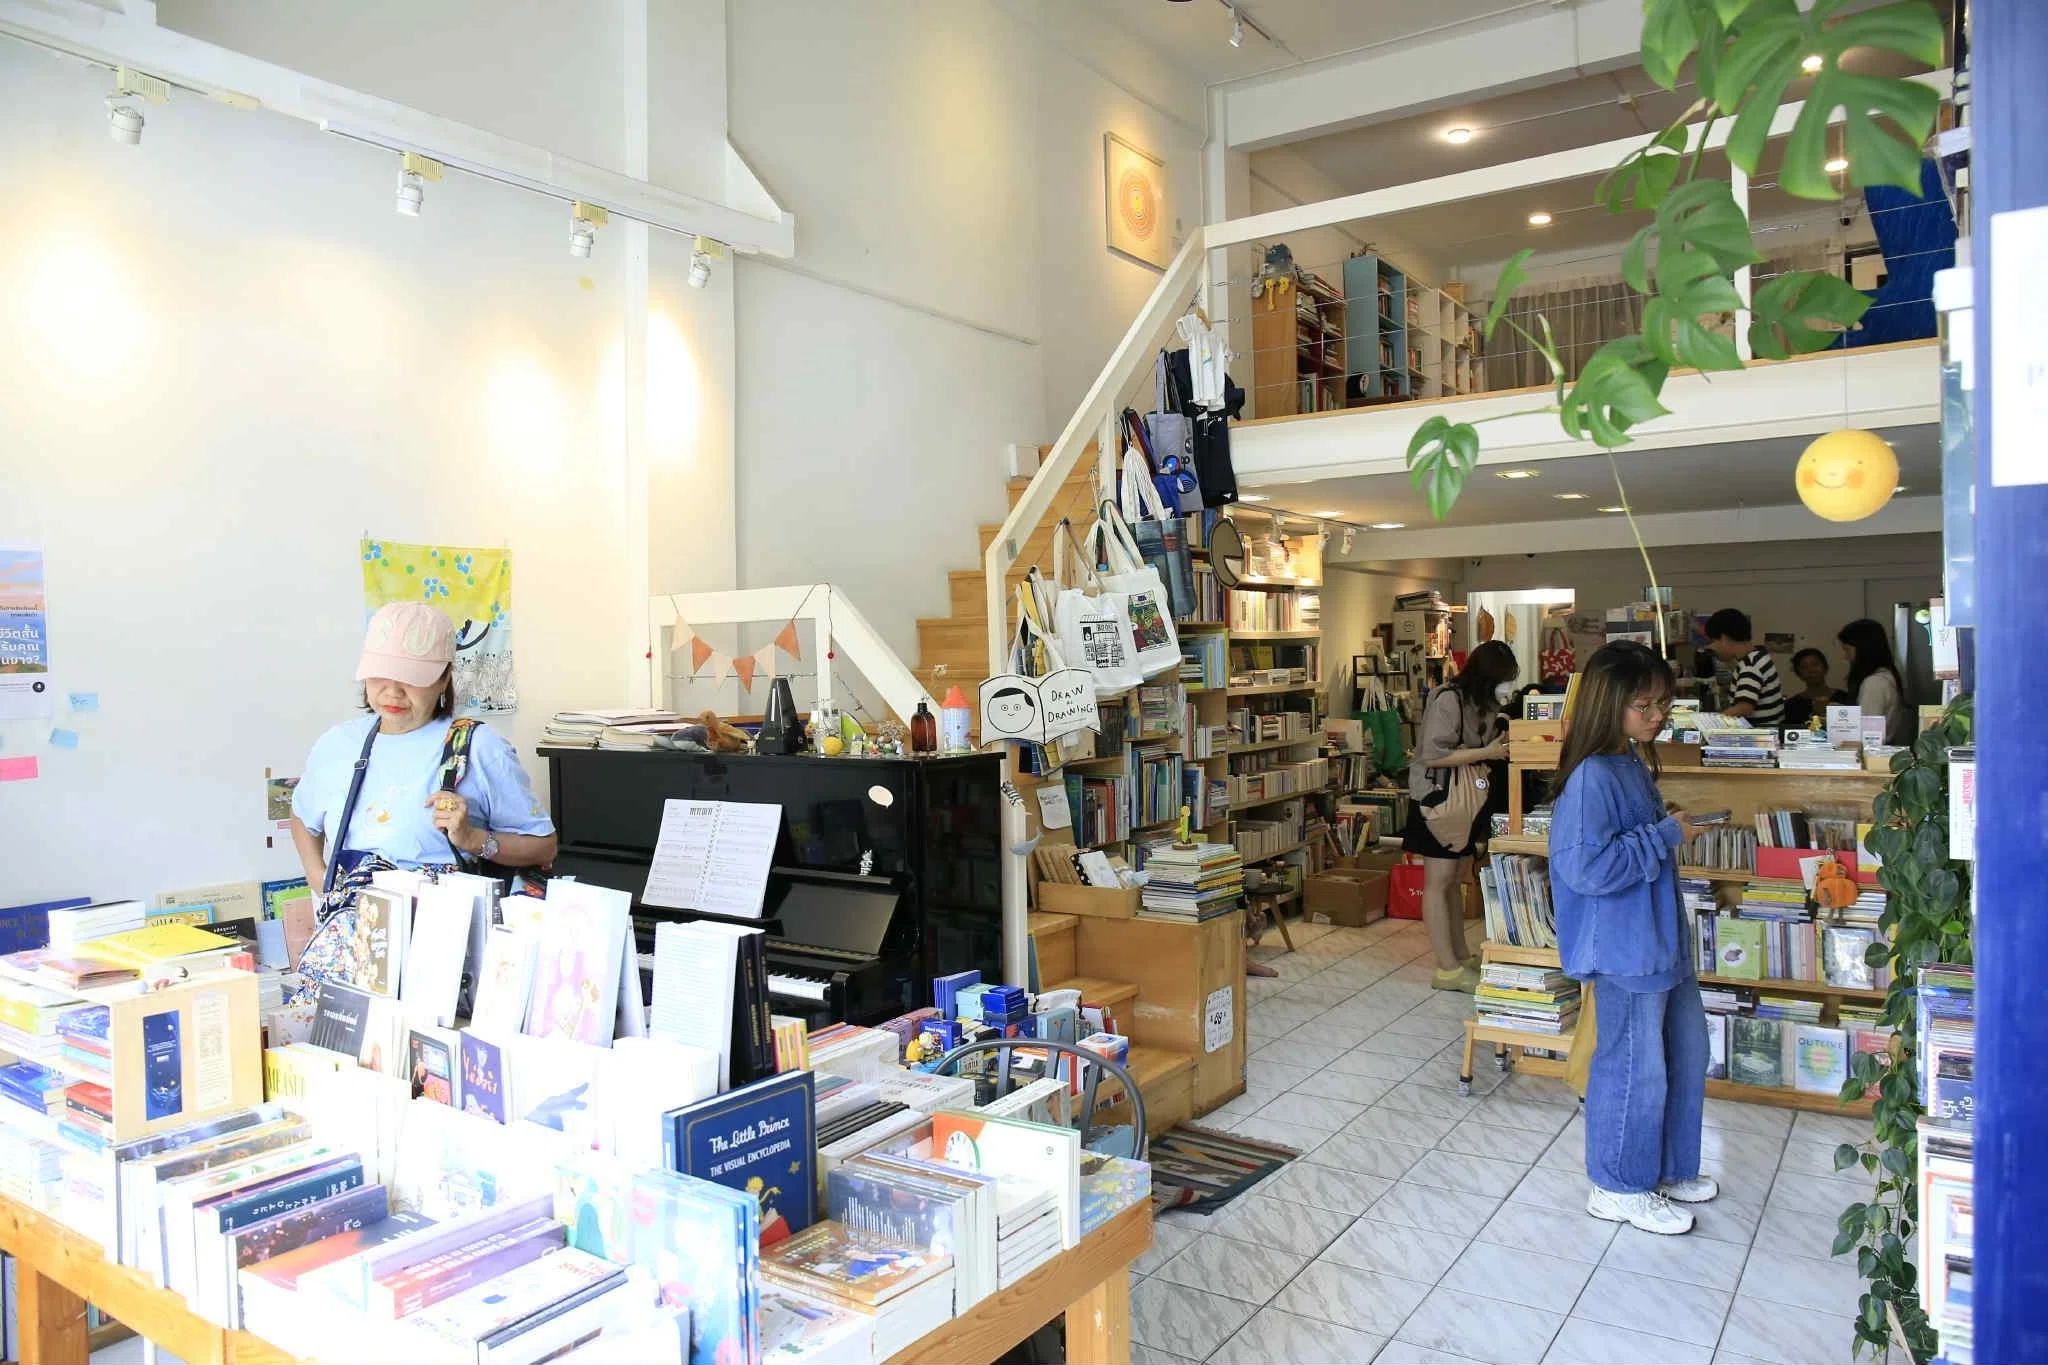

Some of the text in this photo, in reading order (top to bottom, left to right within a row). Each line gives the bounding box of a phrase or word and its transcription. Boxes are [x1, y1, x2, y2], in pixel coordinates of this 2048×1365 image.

[1051, 684, 1083, 702] DRAW
[709, 1117, 790, 1154] The Little Prince
[710, 1139, 791, 1177] THE VISUAL ENCYCLOPEDIA
